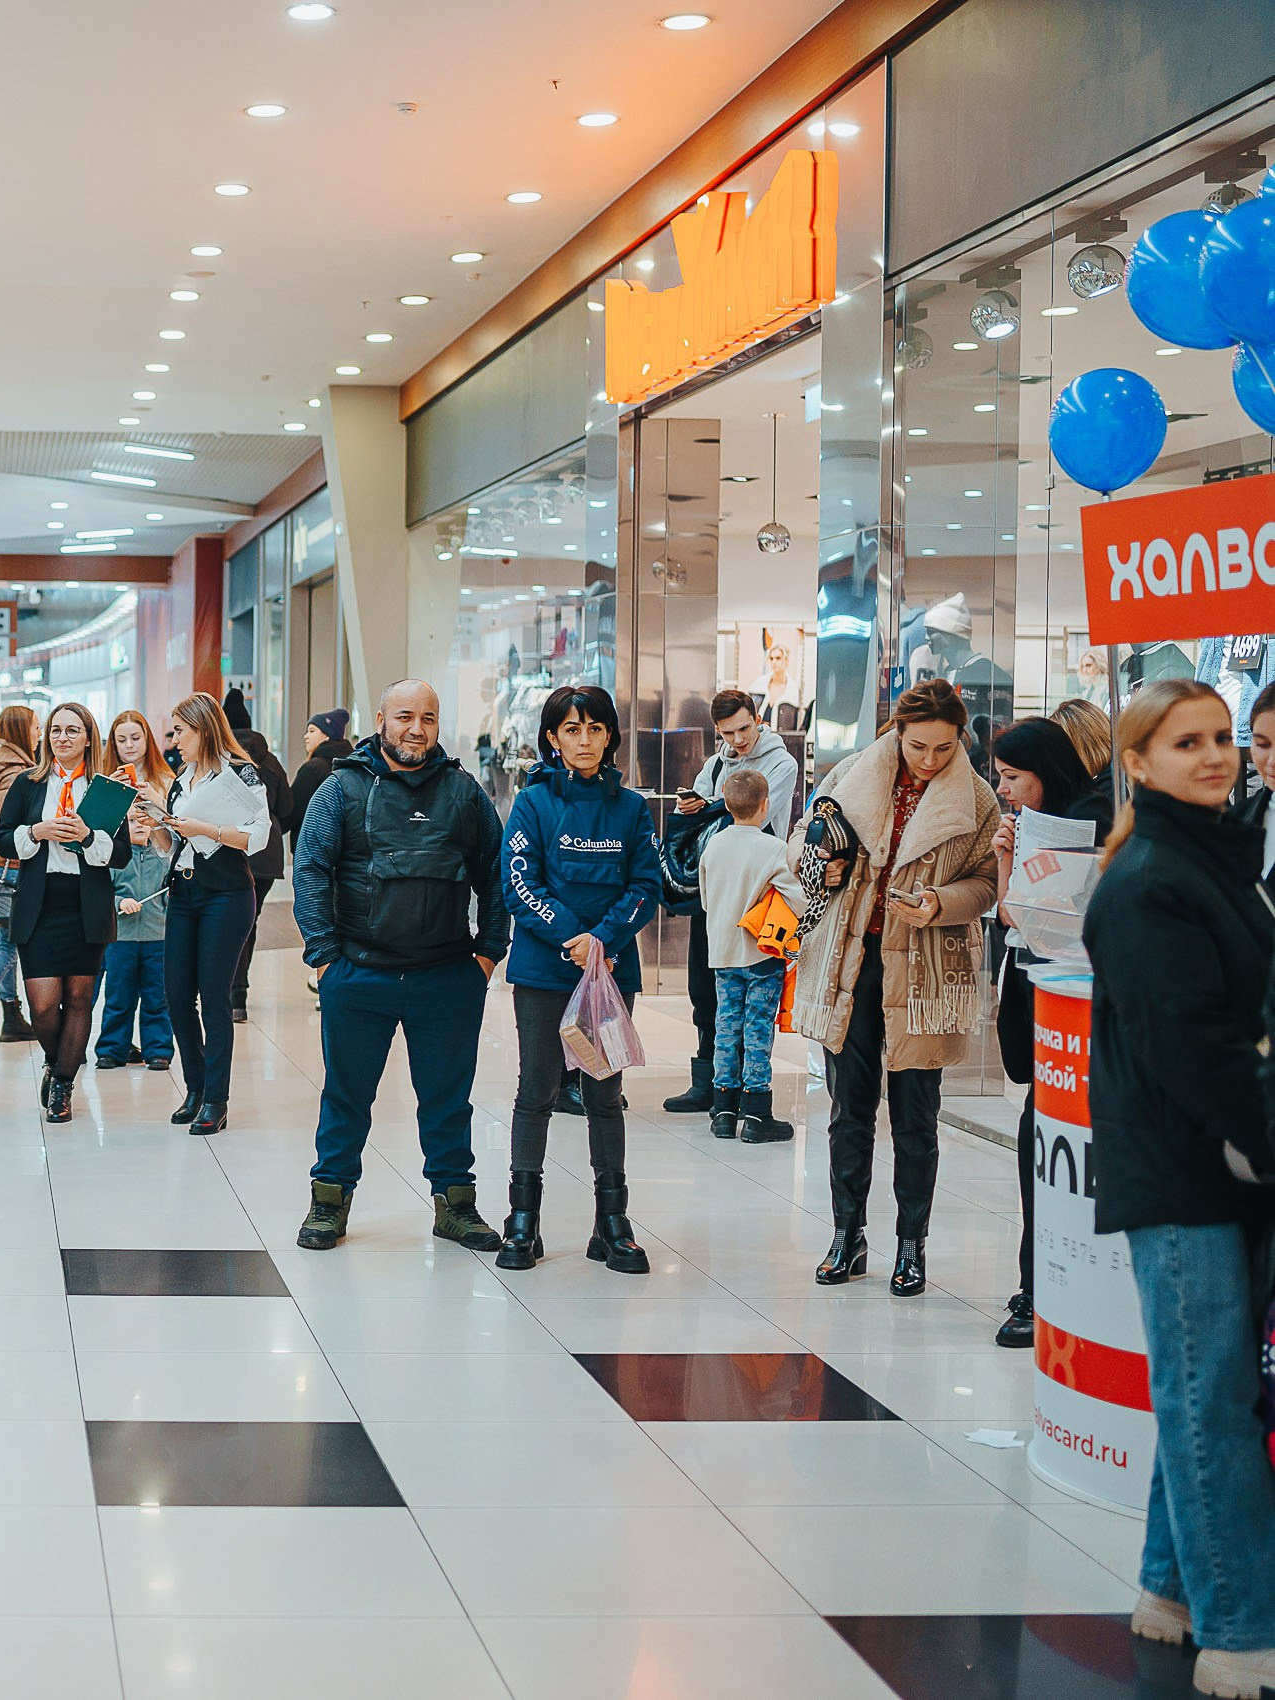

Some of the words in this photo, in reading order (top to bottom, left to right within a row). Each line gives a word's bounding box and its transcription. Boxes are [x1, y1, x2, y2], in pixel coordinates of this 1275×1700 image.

[1232, 634, 1261, 658] 4699
[573, 837, 623, 849] Columbia
[1067, 1034, 1080, 1055] и
